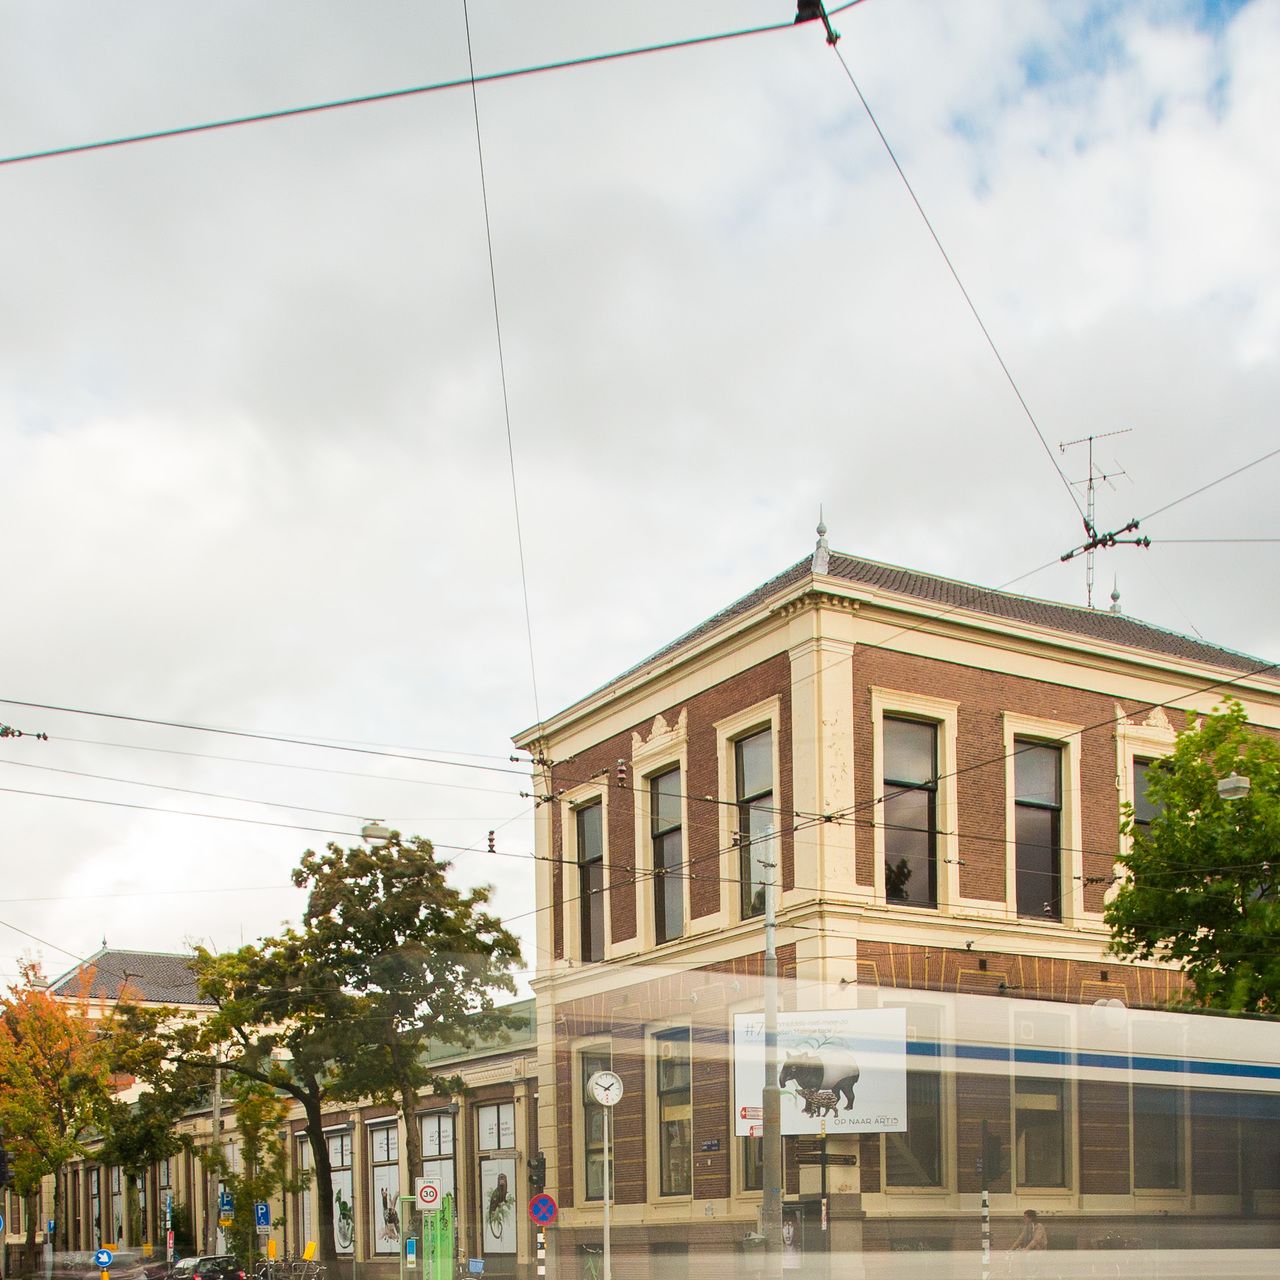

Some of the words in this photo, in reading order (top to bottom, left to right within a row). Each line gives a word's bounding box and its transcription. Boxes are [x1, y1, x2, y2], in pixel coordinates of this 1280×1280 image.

[744, 1022, 765, 1037] #7
[874, 1117, 899, 1125] ARTIS
[224, 1194, 232, 1204] P
[423, 1190, 435, 1198] 30
[258, 1205, 266, 1217] P
